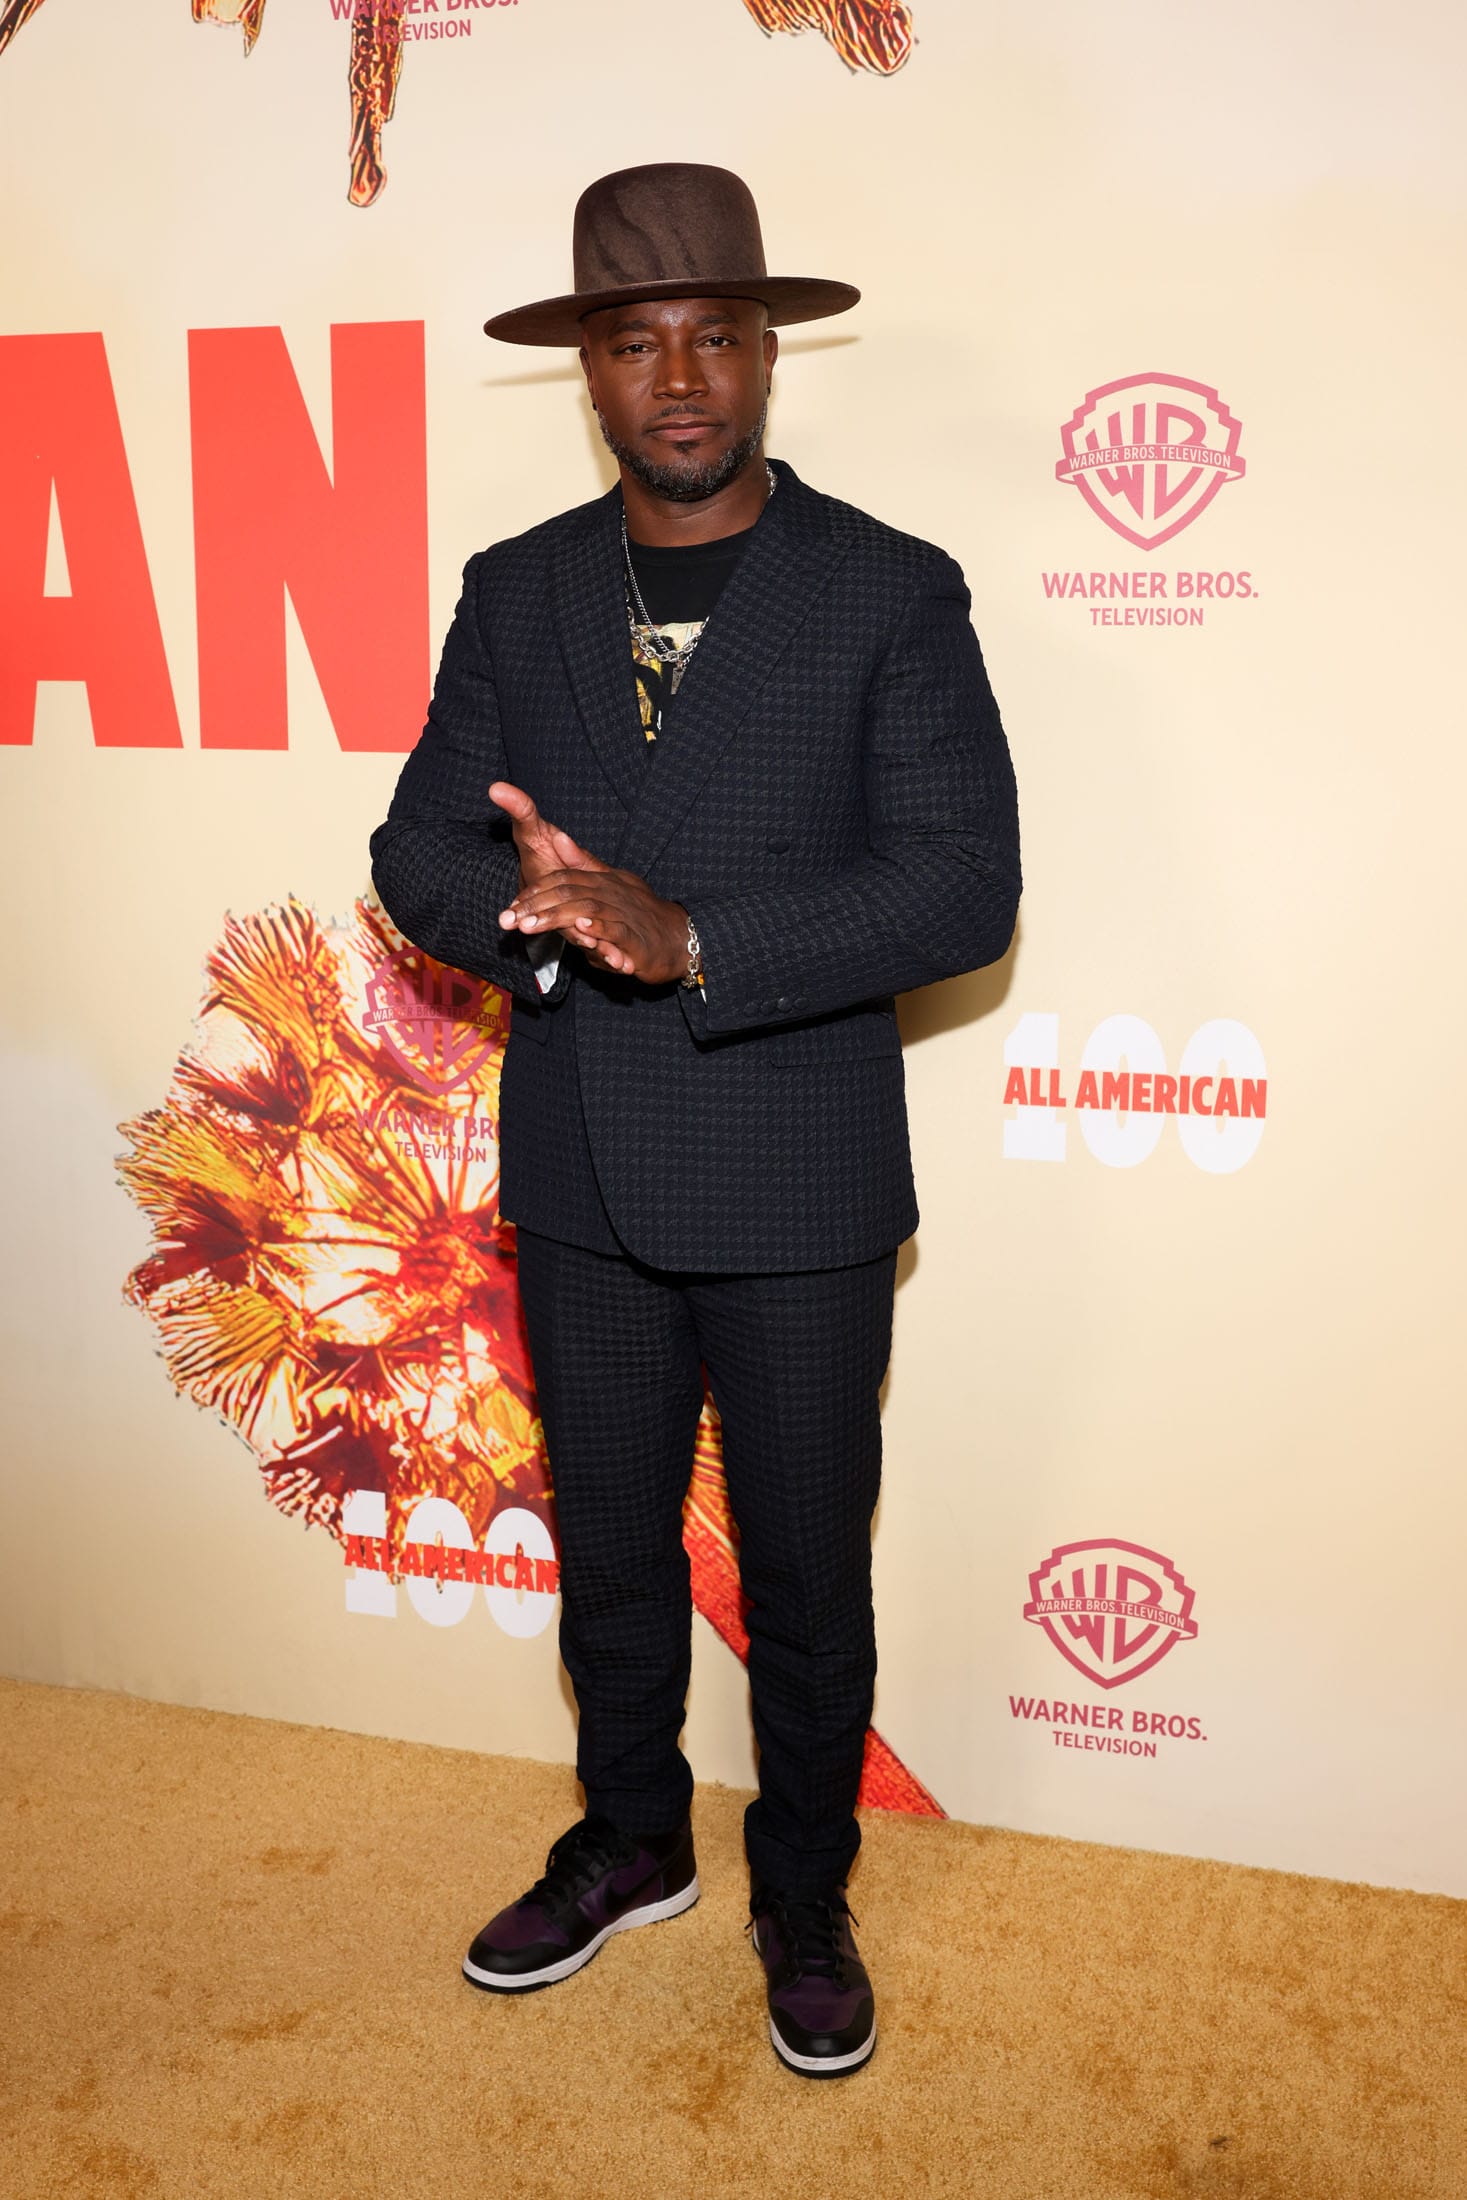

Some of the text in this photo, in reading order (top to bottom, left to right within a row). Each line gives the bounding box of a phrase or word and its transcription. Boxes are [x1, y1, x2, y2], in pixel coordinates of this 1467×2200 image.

[372, 19, 472, 45] TELEVISION
[1069, 446, 1231, 470] WARNER BROS. TELEVISION
[1041, 571, 1259, 599] WARNER BROS.
[1090, 608, 1204, 626] TELEVISION
[1002, 1012, 1267, 1175] 100
[1003, 1066, 1267, 1118] ALL AMERICAN
[355, 1109, 499, 1140] WARNER BR
[394, 1141, 487, 1162] TELEVISION
[344, 1533, 560, 1595] ALL AMERICAN
[1036, 1600, 1185, 1628] WARNER BROS. TELEVISION
[1009, 1696, 1207, 1741] WARNER BROS.
[1052, 1731, 1157, 1758] TELEVISION
